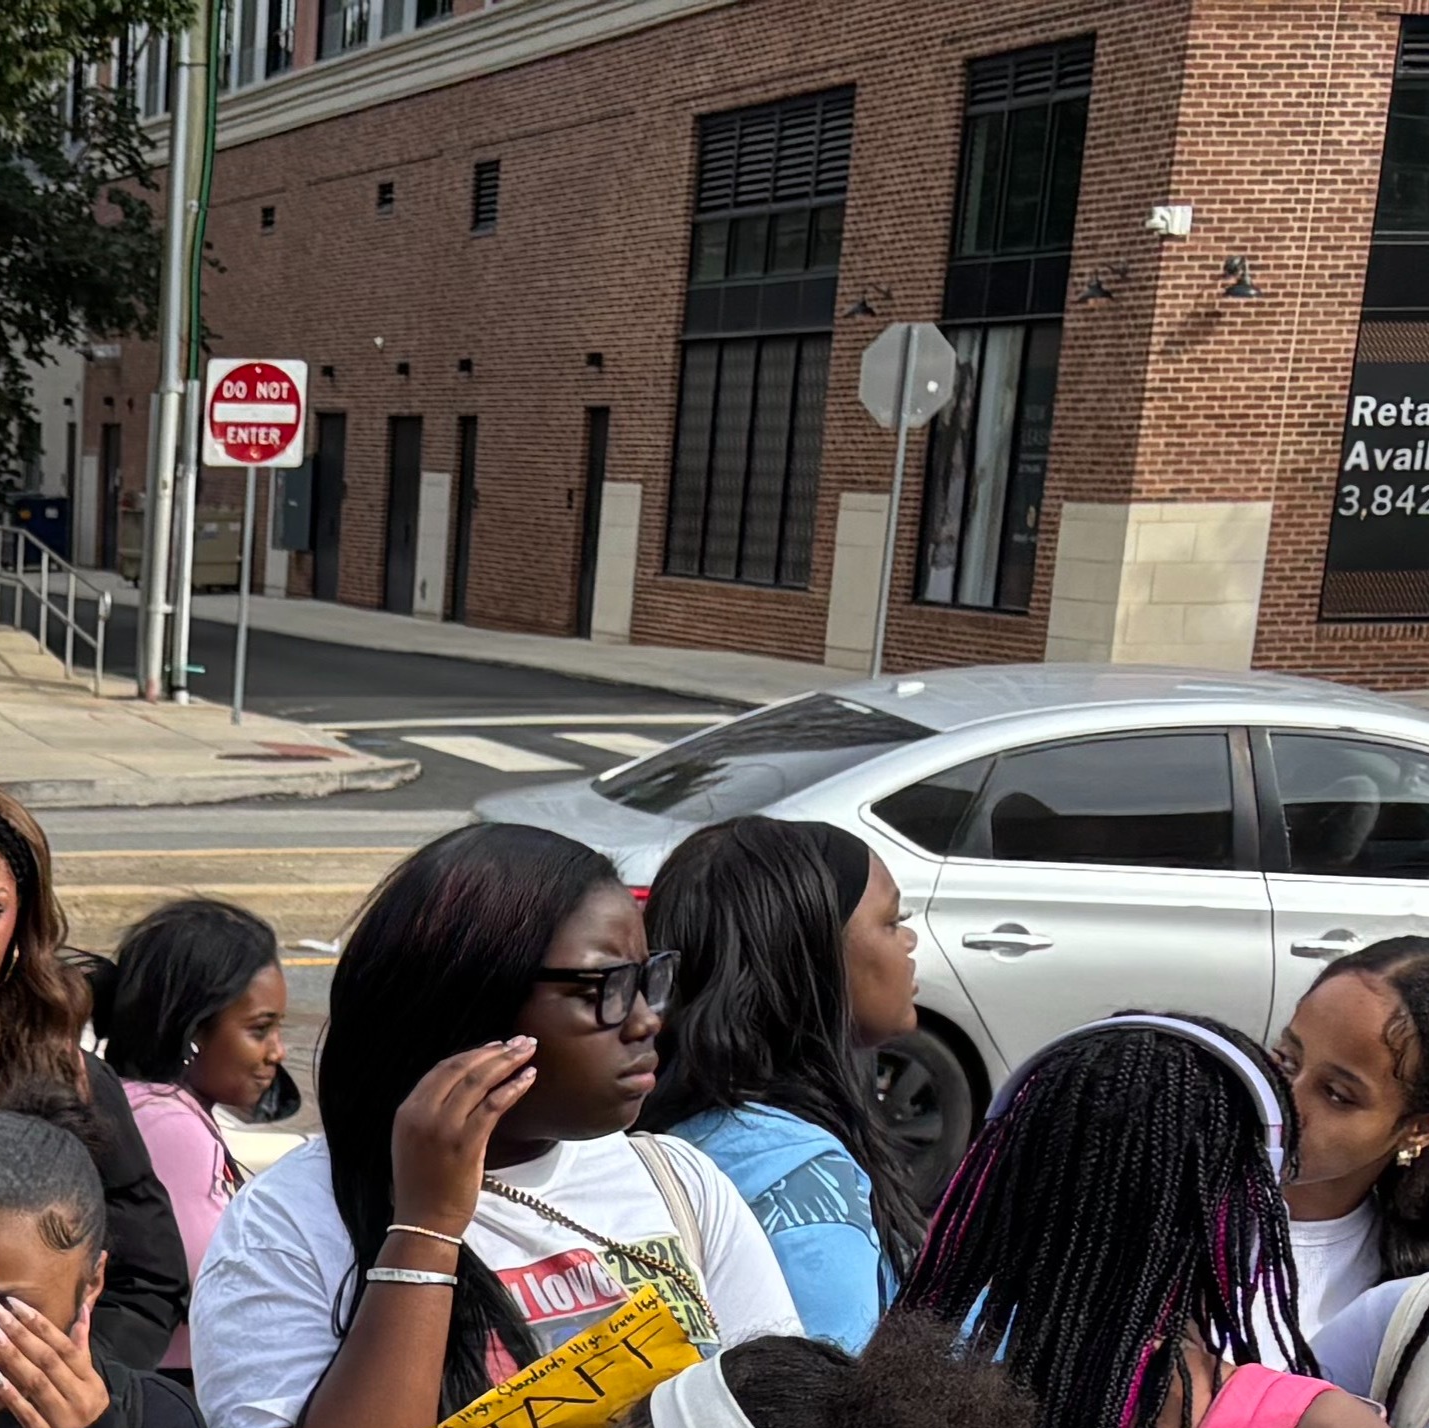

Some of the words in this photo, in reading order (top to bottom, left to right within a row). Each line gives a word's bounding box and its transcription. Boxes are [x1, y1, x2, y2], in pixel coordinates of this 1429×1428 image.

[223, 380, 247, 399] DO
[256, 381, 290, 399] NOT
[227, 426, 281, 445] ENTER
